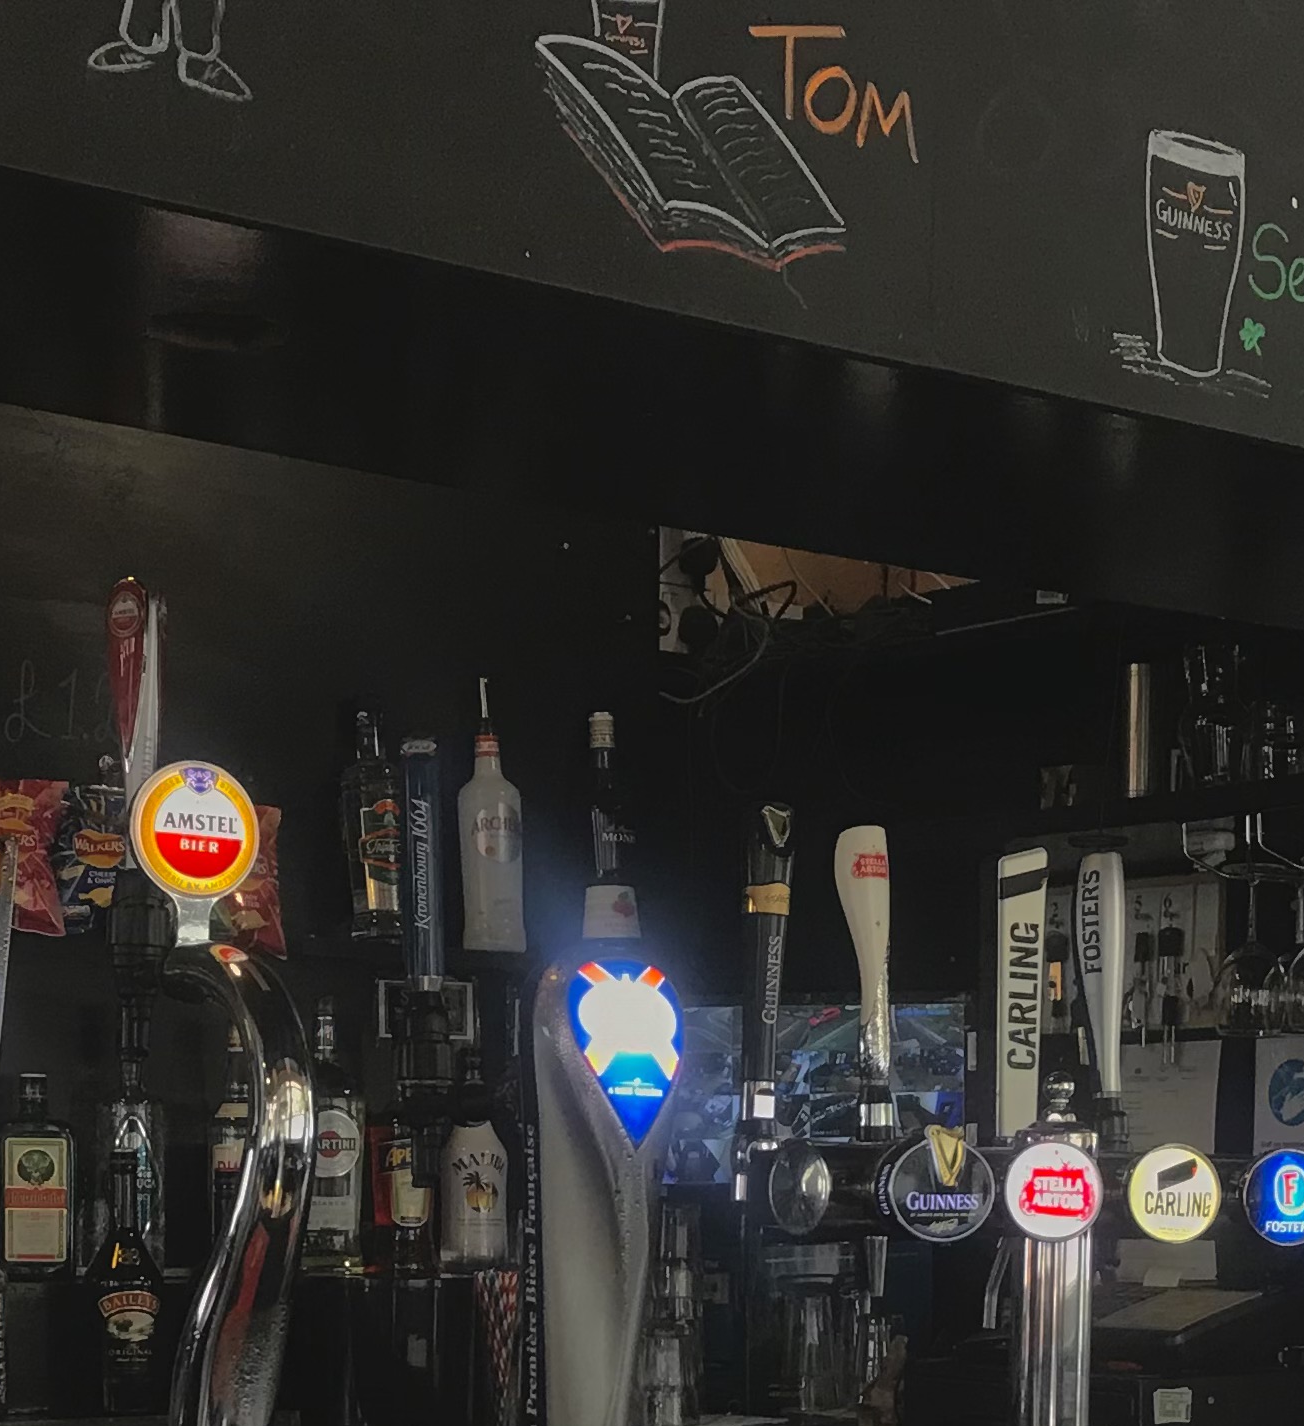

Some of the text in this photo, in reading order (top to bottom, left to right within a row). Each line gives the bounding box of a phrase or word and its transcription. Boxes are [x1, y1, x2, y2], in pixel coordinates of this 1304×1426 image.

[748, 24, 919, 164] TOM
[1155, 198, 1232, 241] GUINNESS
[163, 812, 238, 835] AMSTEL
[471, 815, 515, 836] ARCHE
[74, 837, 126, 853] WALKERS
[179, 838, 219, 854] BIER
[409, 798, 432, 930] Kronenbourg 1664
[860, 865, 887, 874] ARTO
[1081, 869, 1103, 975] FOSTER'S
[761, 935, 782, 1025] GUINNESS
[1006, 922, 1040, 1070] CARLING
[386, 1147, 412, 1169] APE
[1033, 1176, 1084, 1192] STELLA
[1282, 1171, 1298, 1206] F
[906, 1191, 979, 1211] GUINNESS
[1145, 1191, 1212, 1217] CARLING
[103, 1294, 160, 1311] BAILEYS
[525, 1311, 537, 1416] Première
